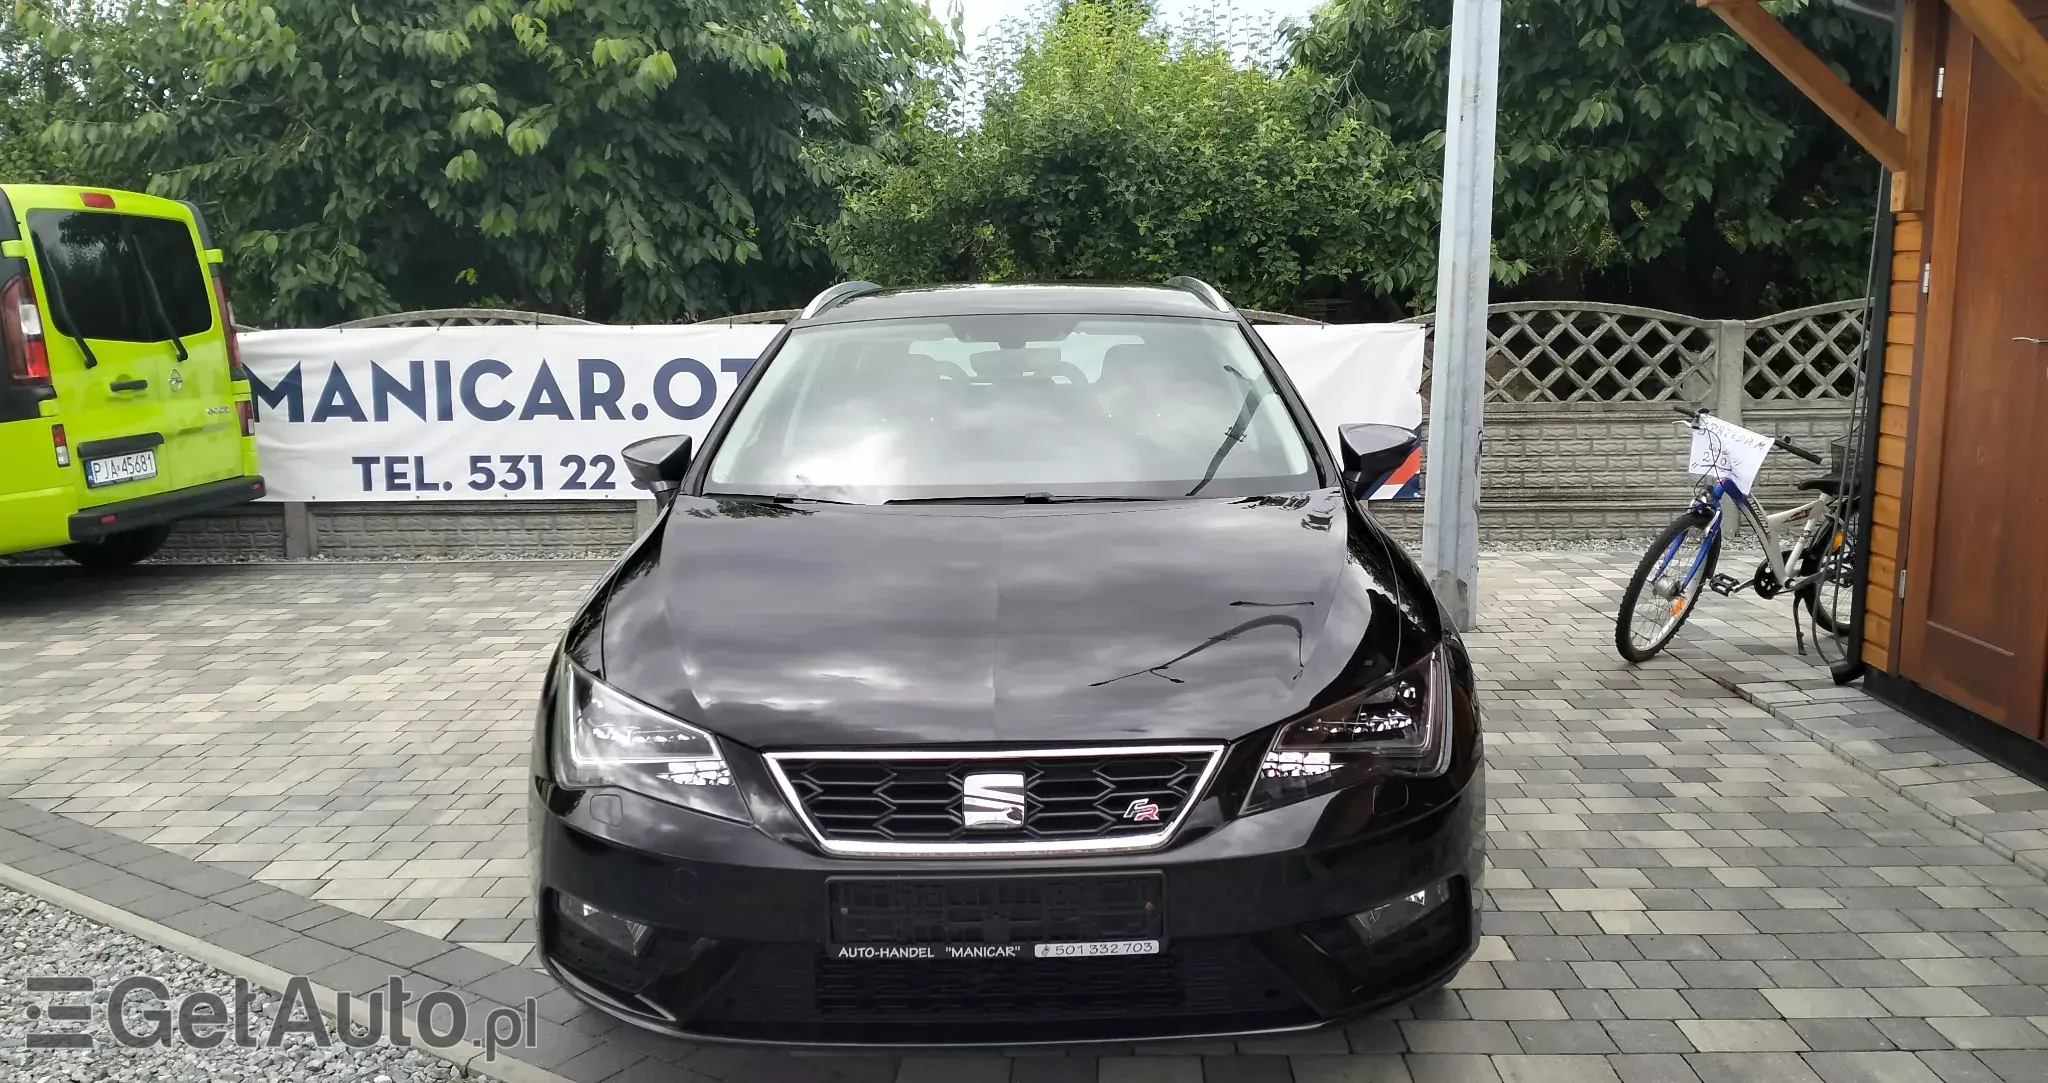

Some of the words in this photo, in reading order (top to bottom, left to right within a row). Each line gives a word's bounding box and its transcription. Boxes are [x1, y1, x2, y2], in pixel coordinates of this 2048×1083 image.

[352, 455, 453, 491] TEL.
[467, 454, 543, 491] 531
[559, 454, 616, 490] 22
[838, 946, 935, 958] AUTO-HANDEL
[945, 945, 1021, 957] "MANICAR"
[1055, 945, 1083, 955] 501
[1089, 943, 1119, 954] 332
[1123, 942, 1153, 953] 703
